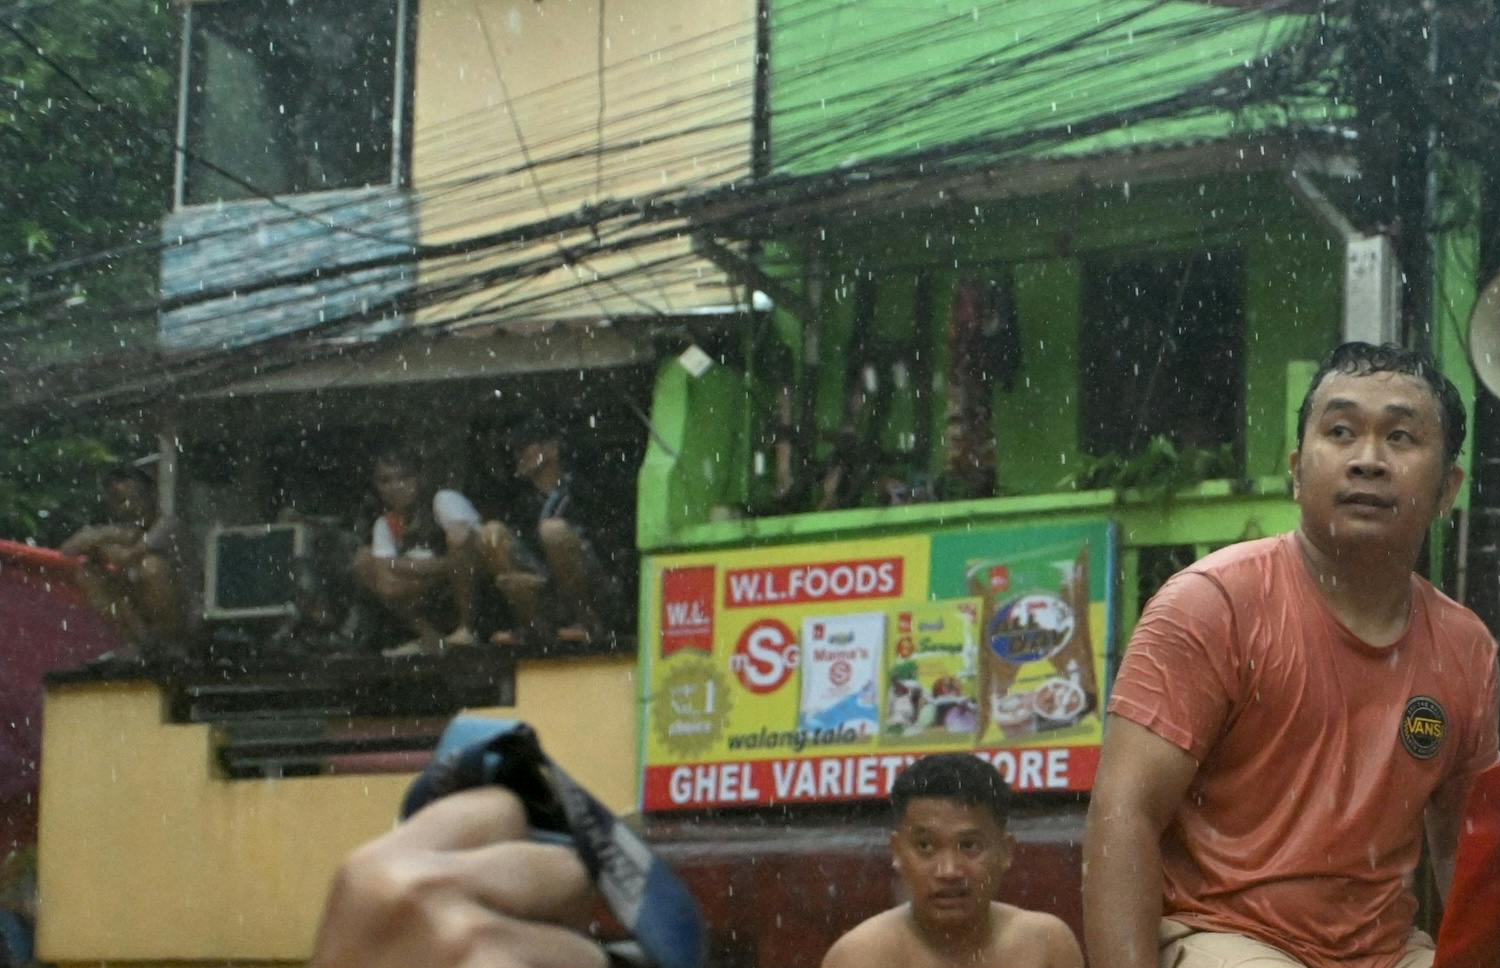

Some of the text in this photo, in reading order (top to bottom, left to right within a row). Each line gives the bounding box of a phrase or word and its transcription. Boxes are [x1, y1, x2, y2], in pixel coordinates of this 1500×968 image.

[729, 725, 807, 751] walang
[1407, 716, 1442, 737] VANS
[669, 763, 760, 804] GHEL
[772, 754, 914, 798] VARIET
